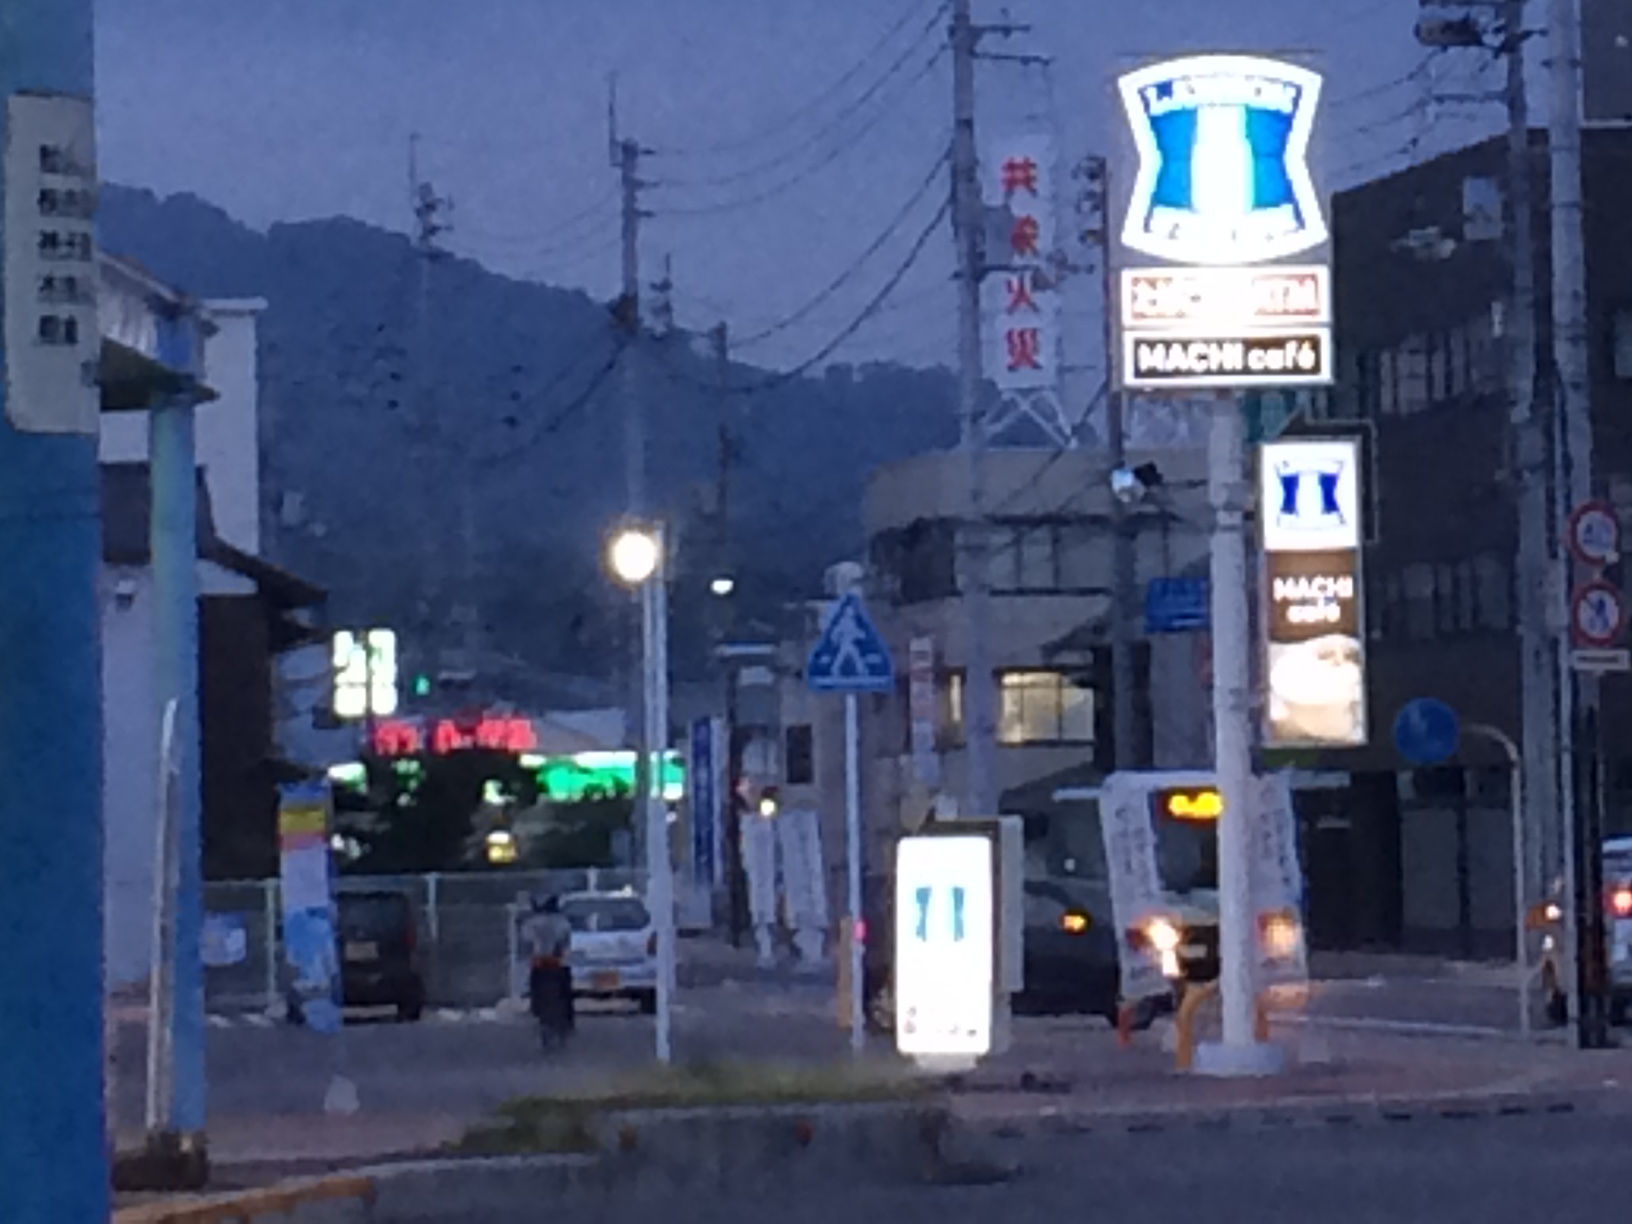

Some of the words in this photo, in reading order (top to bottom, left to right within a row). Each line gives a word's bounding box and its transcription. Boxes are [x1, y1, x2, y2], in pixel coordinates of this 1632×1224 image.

[1139, 343, 1243, 371] MACHI
[1248, 341, 1315, 370] café
[1274, 576, 1353, 600] MACHI
